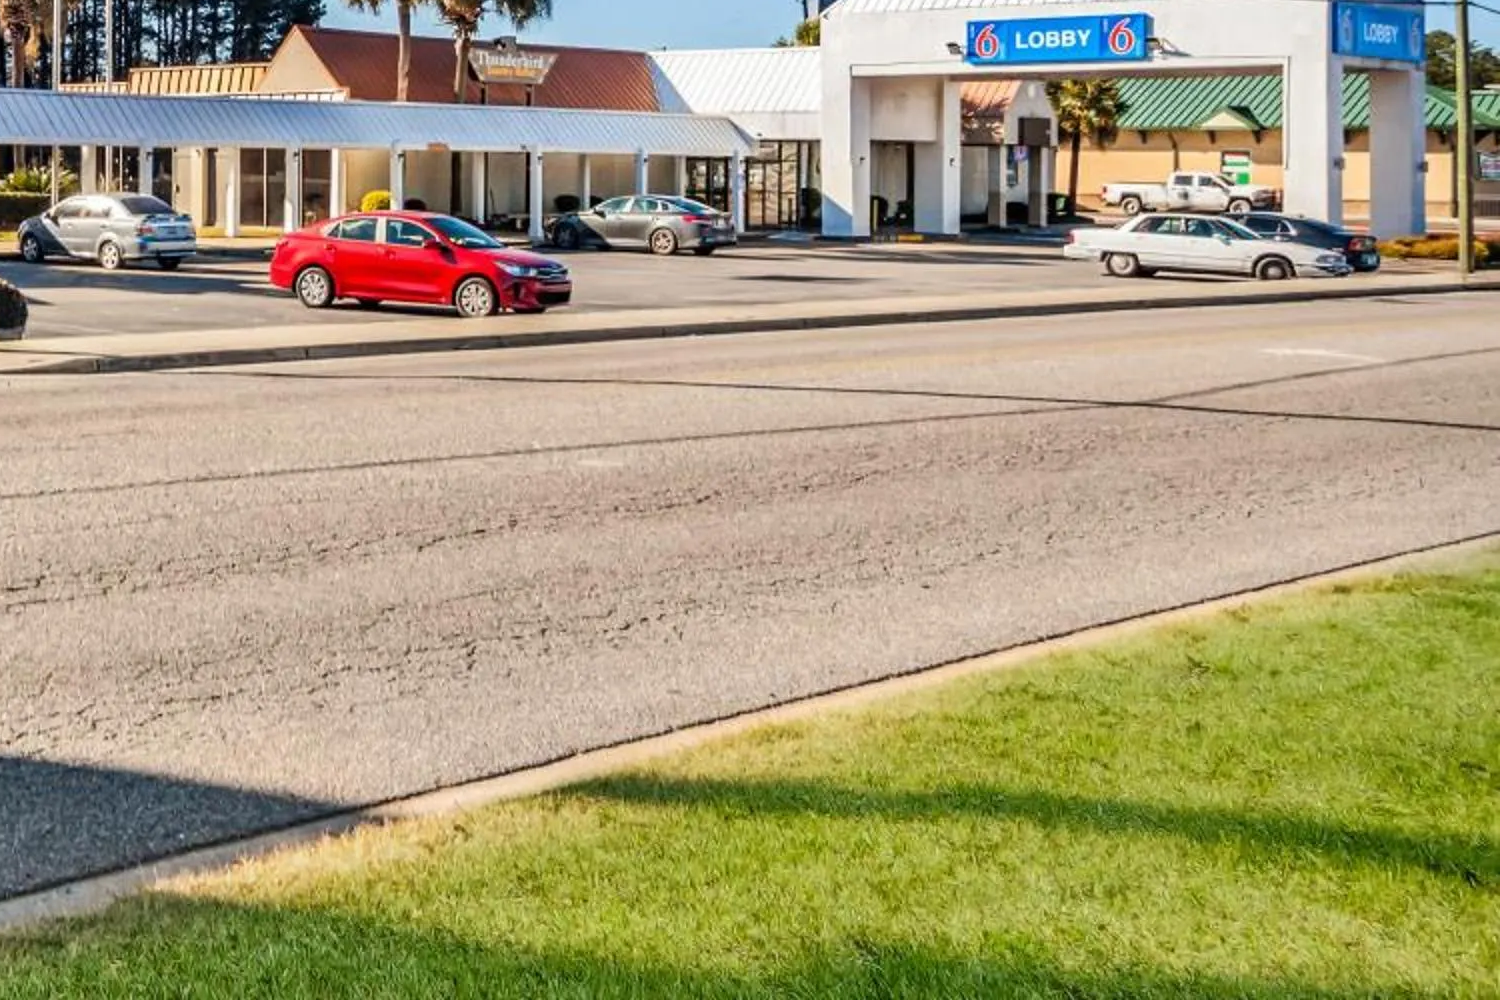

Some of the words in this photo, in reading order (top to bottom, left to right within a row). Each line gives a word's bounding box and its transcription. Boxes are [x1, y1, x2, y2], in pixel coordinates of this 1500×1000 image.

[975, 23, 999, 59] 6
[1015, 29, 1091, 49] LOBBY
[1108, 17, 1135, 56] 6
[1363, 23, 1398, 44] LOBBY
